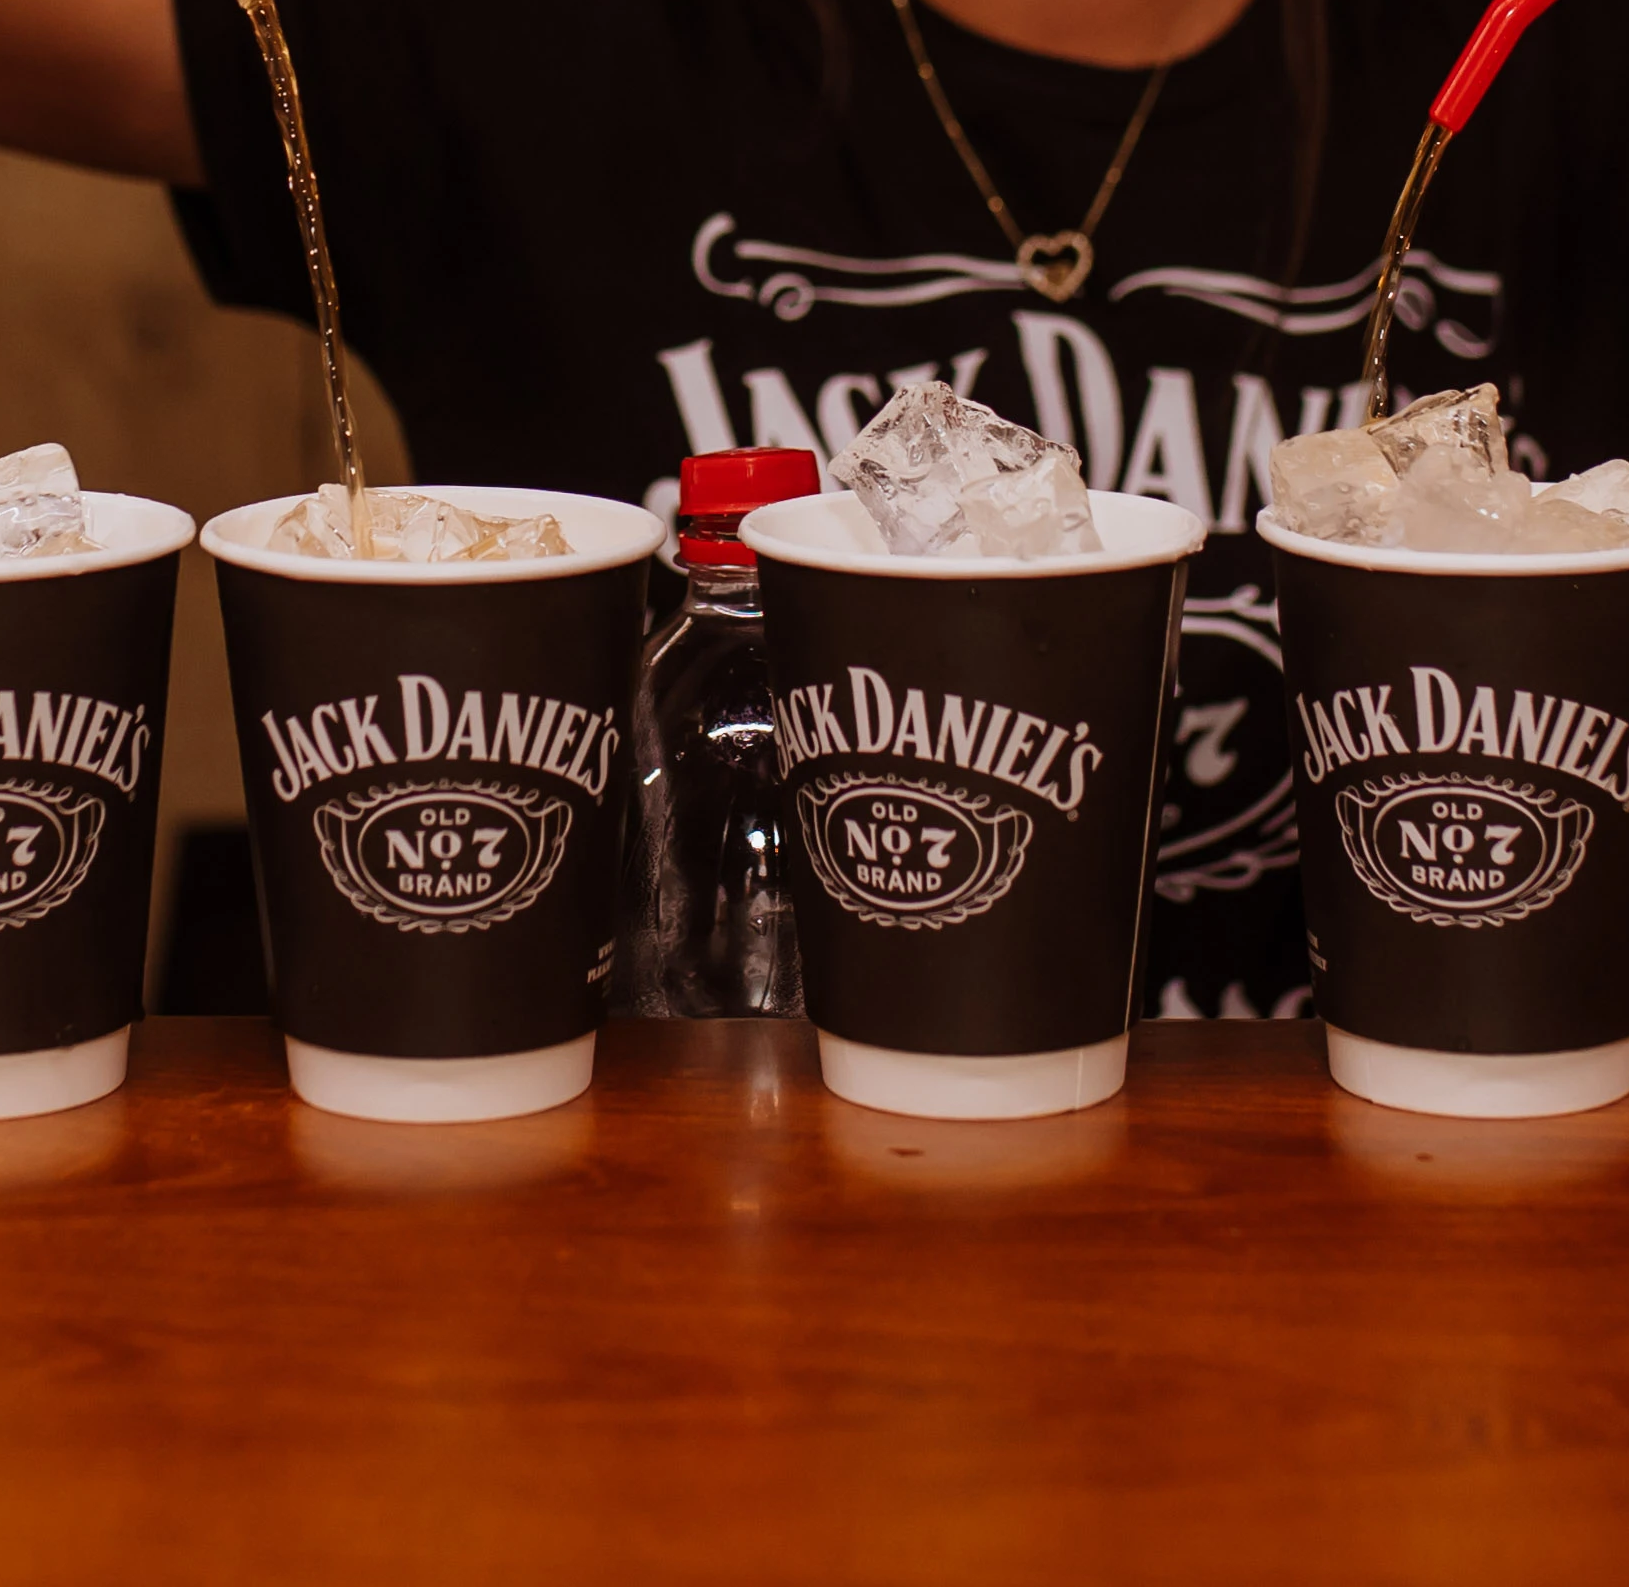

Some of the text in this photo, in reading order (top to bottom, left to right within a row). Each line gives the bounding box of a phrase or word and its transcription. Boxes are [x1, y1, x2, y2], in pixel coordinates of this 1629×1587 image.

[261, 674, 620, 802] JACK DANIEL'S
[847, 666, 1103, 811] DANIEL'S
[1175, 697, 1249, 787] 7
[1296, 685, 1410, 783] JACK
[420, 808, 470, 826] OLD
[872, 802, 918, 822] OLD
[1432, 802, 1483, 819] OLD
[399, 873, 492, 897] BRAND
[857, 864, 942, 893] BRAND
[1412, 865, 1505, 892] BRAND
